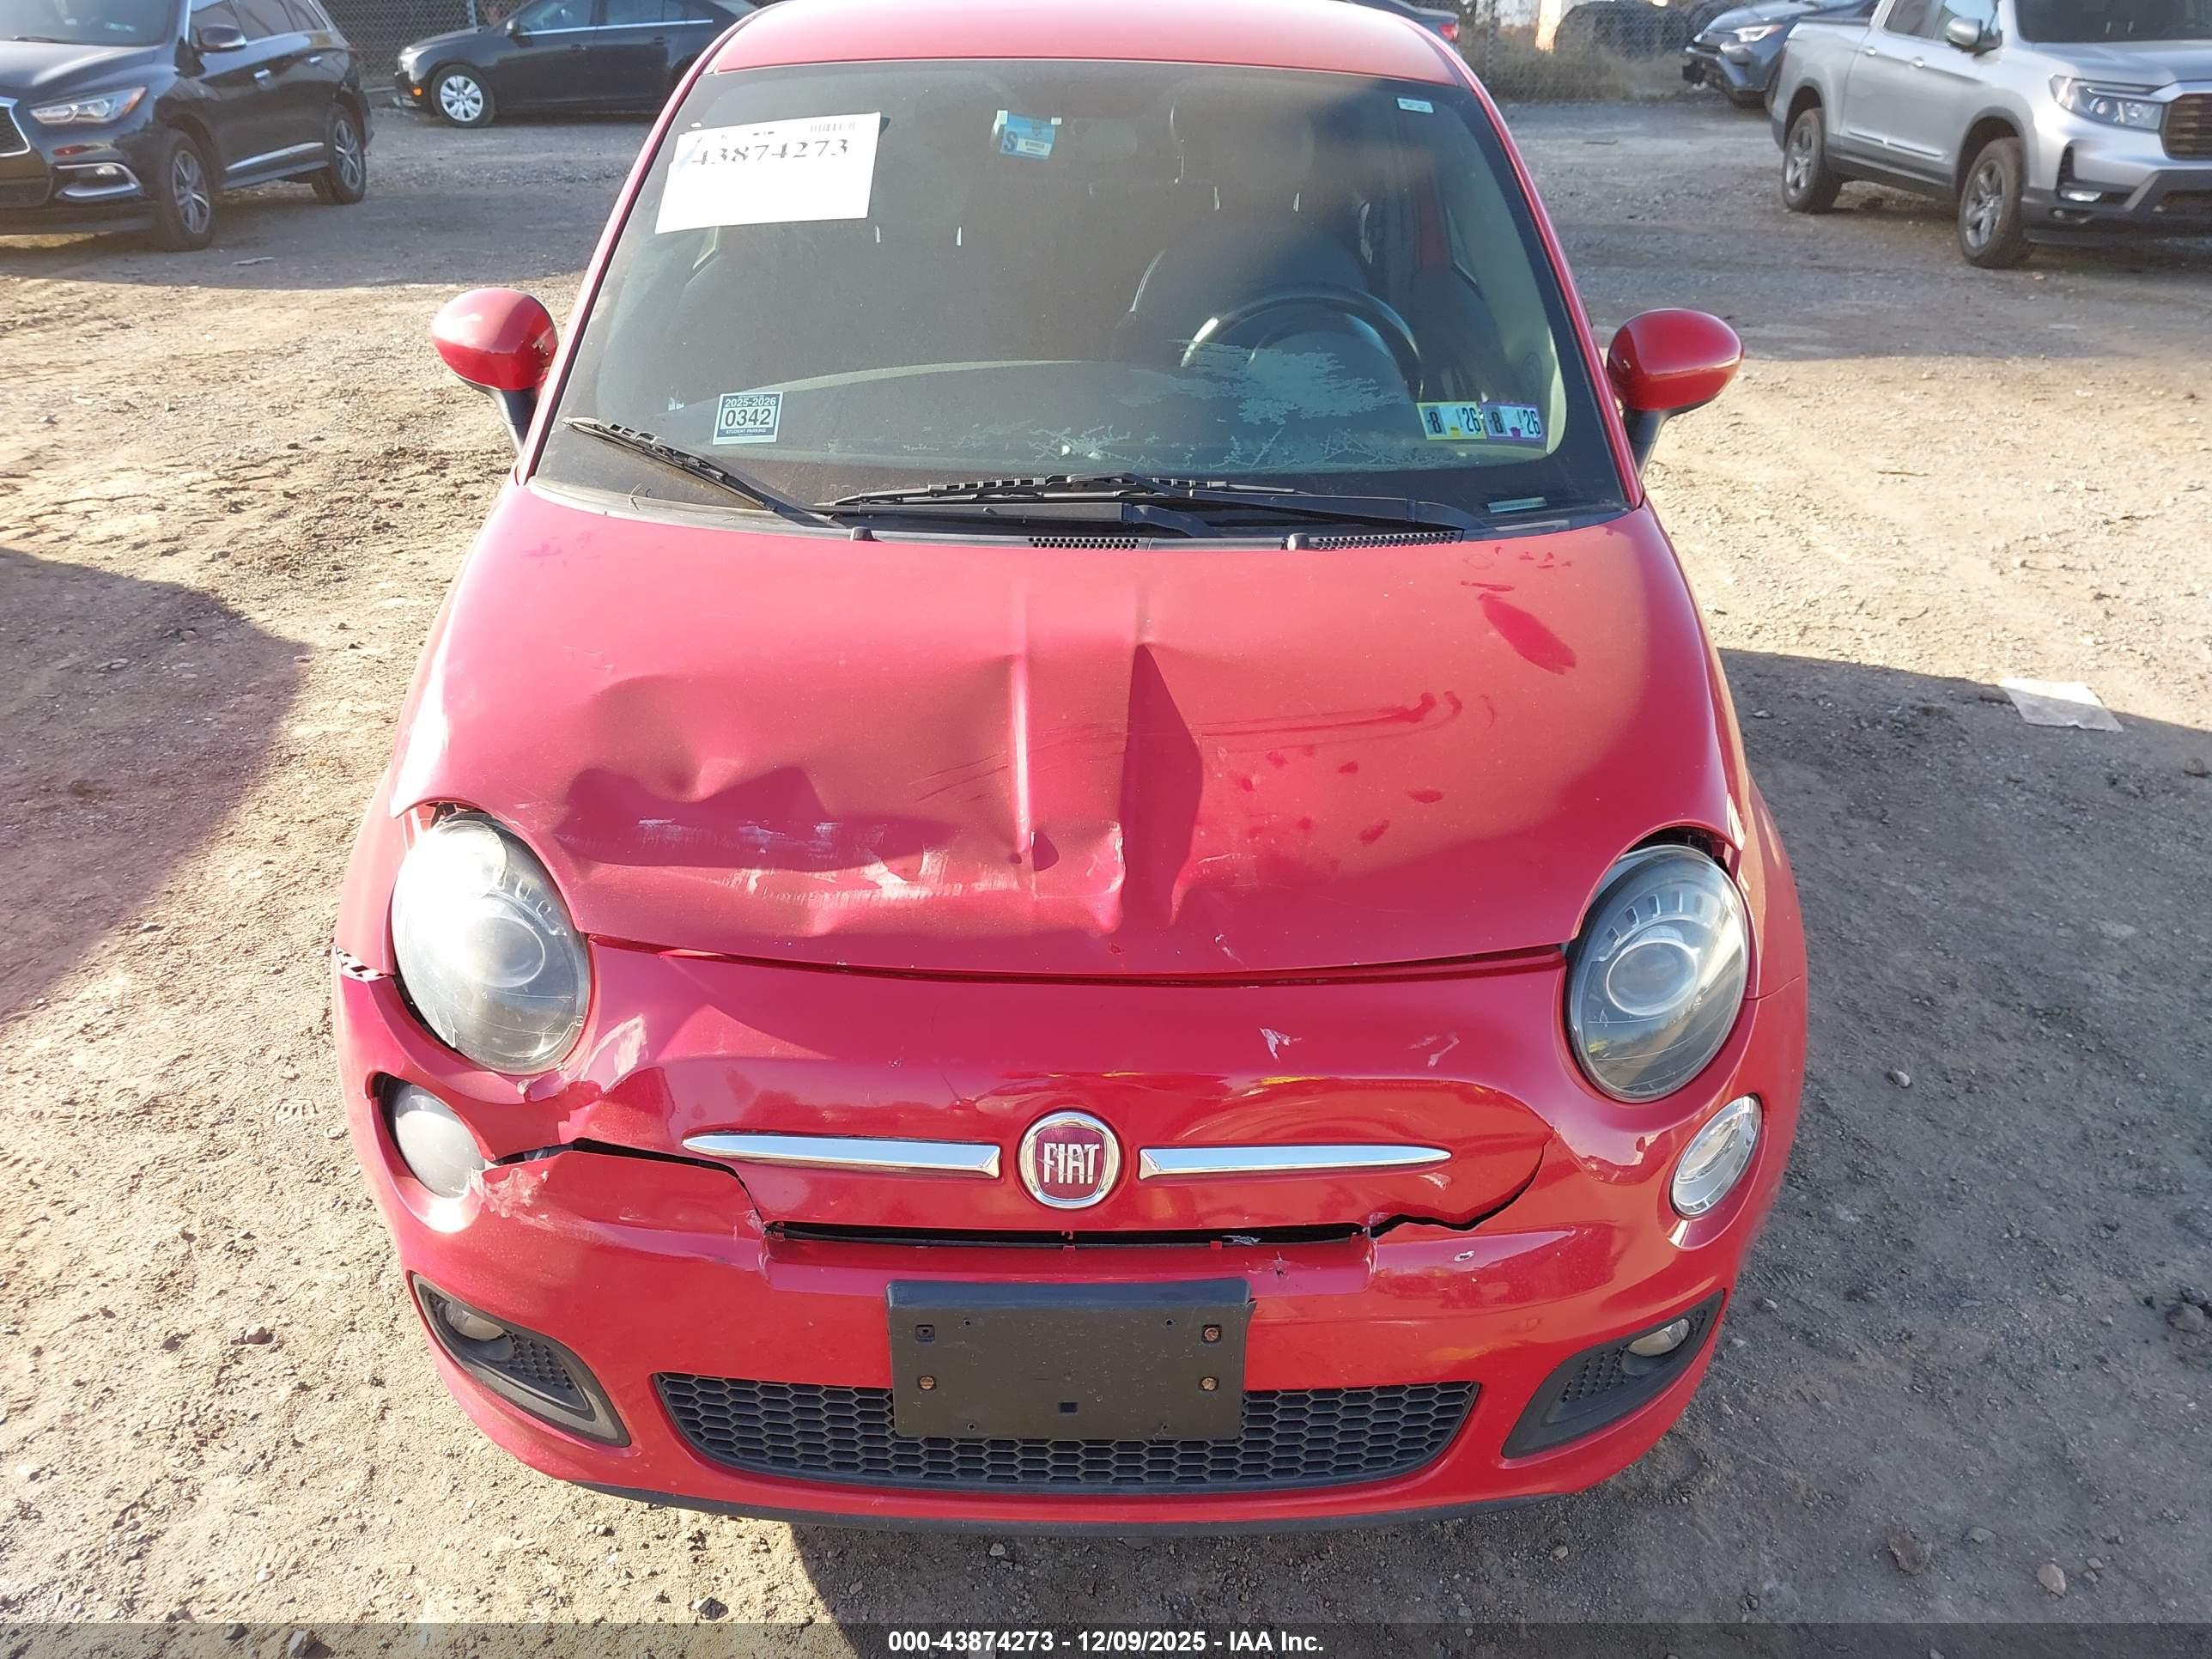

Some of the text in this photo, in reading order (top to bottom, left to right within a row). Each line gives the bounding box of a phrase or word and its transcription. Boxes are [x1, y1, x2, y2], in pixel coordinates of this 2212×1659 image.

[725, 398, 776, 407] 2025-2026
[725, 409, 771, 427] 0342
[1429, 407, 1482, 434] 8 26
[1491, 409, 1541, 435] 8 26
[1043, 1142, 1100, 1184] FIAT
